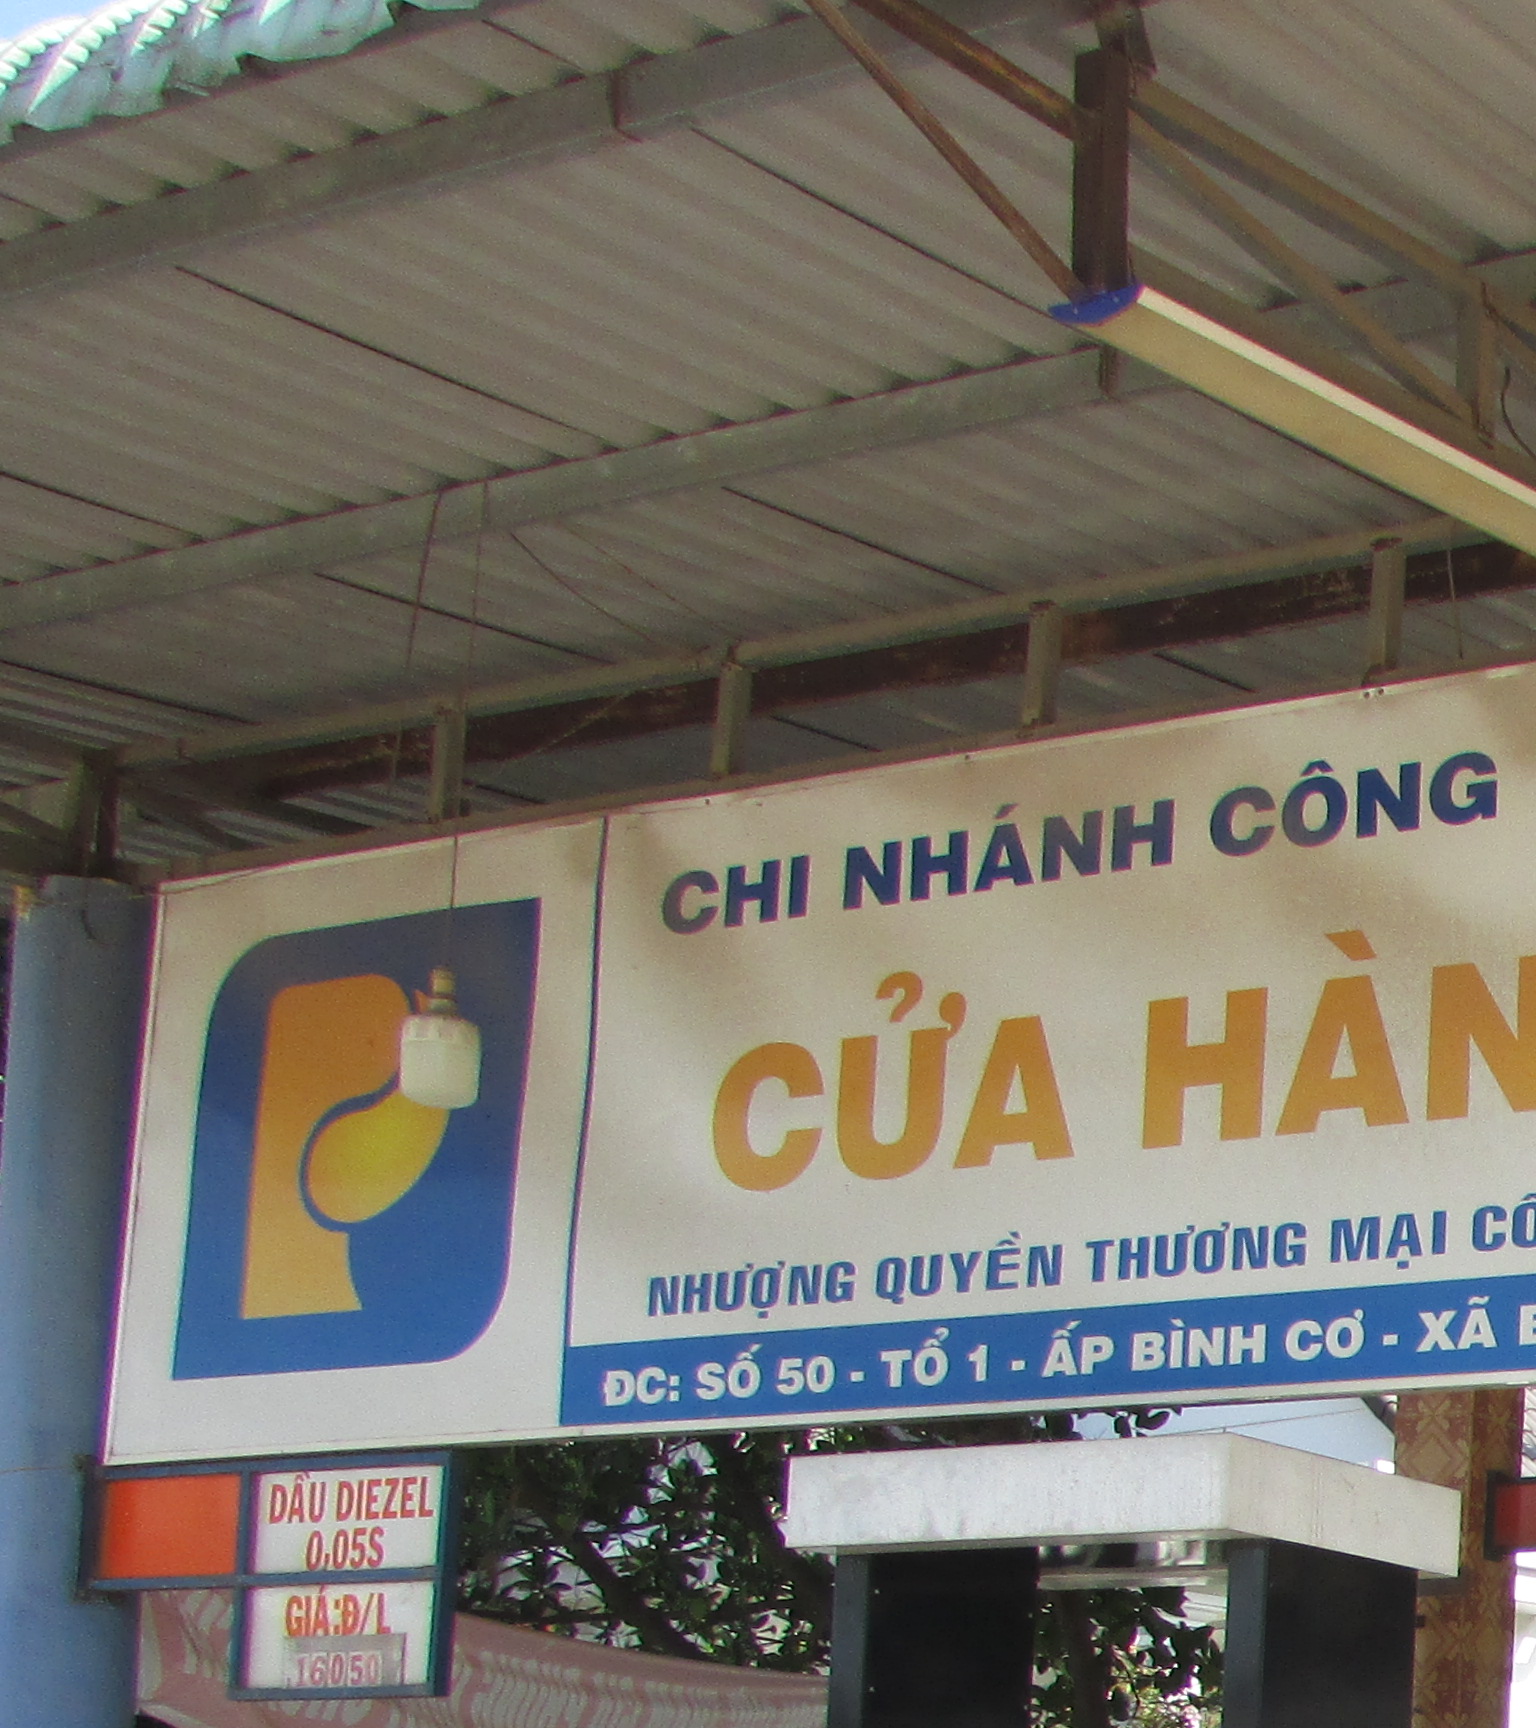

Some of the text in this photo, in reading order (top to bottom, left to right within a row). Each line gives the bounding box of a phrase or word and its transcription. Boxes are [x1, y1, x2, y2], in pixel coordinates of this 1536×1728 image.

[659, 855, 809, 934] CHI
[843, 799, 1174, 909] NHÁNH
[1210, 752, 1497, 856] CÔNG
[714, 971, 1070, 1189] CỬA
[648, 1261, 855, 1320] NHƯỢNG
[875, 1230, 1062, 1304] QUYỀN
[1086, 1222, 1306, 1282] THƯƠNG
[1330, 1211, 1446, 1269] MẠI
[601, 1367, 679, 1406] ĐC:
[696, 1342, 760, 1399] SỐ
[777, 1356, 834, 1394] 50
[881, 1328, 948, 1387] TỔ
[969, 1345, 987, 1381] 1
[1042, 1320, 1113, 1377] ẤP
[1132, 1318, 1266, 1371] BÌNH
[1285, 1309, 1363, 1360] CƠ
[1417, 1295, 1496, 1351] XÃ
[269, 1470, 434, 1524] DẦU DIEZEL
[306, 1526, 385, 1571] 0,05S
